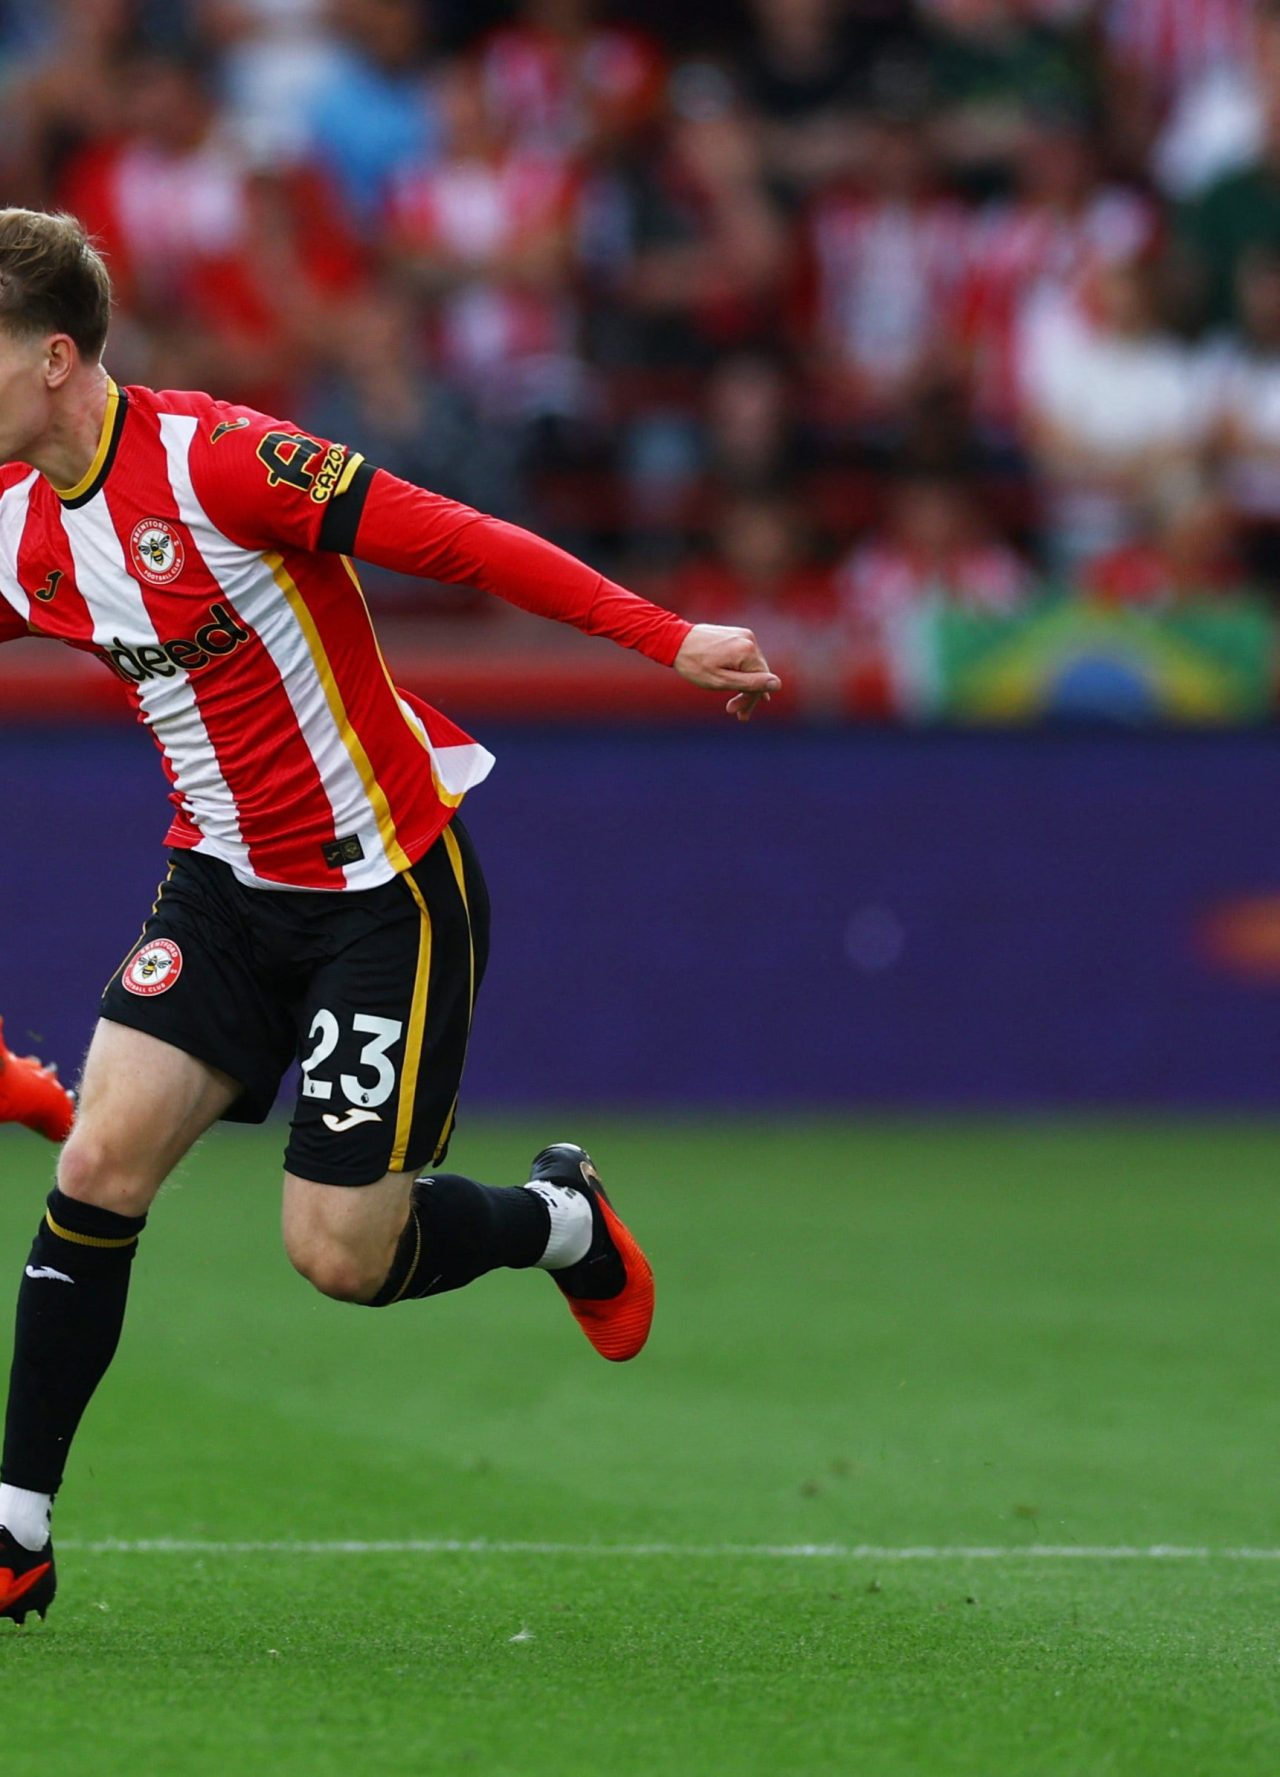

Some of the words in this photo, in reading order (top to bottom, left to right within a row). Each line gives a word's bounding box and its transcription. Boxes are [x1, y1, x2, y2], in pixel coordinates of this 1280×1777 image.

[310, 443, 345, 504] CAZO
[133, 520, 169, 543] BRENTFORD
[144, 569, 173, 581] FOOTBALL
[170, 558, 182, 575] CLUB
[105, 603, 249, 682] deed
[139, 940, 178, 958] BRENTFORD
[147, 983, 166, 993] CLUB
[301, 1008, 403, 1108] 23
